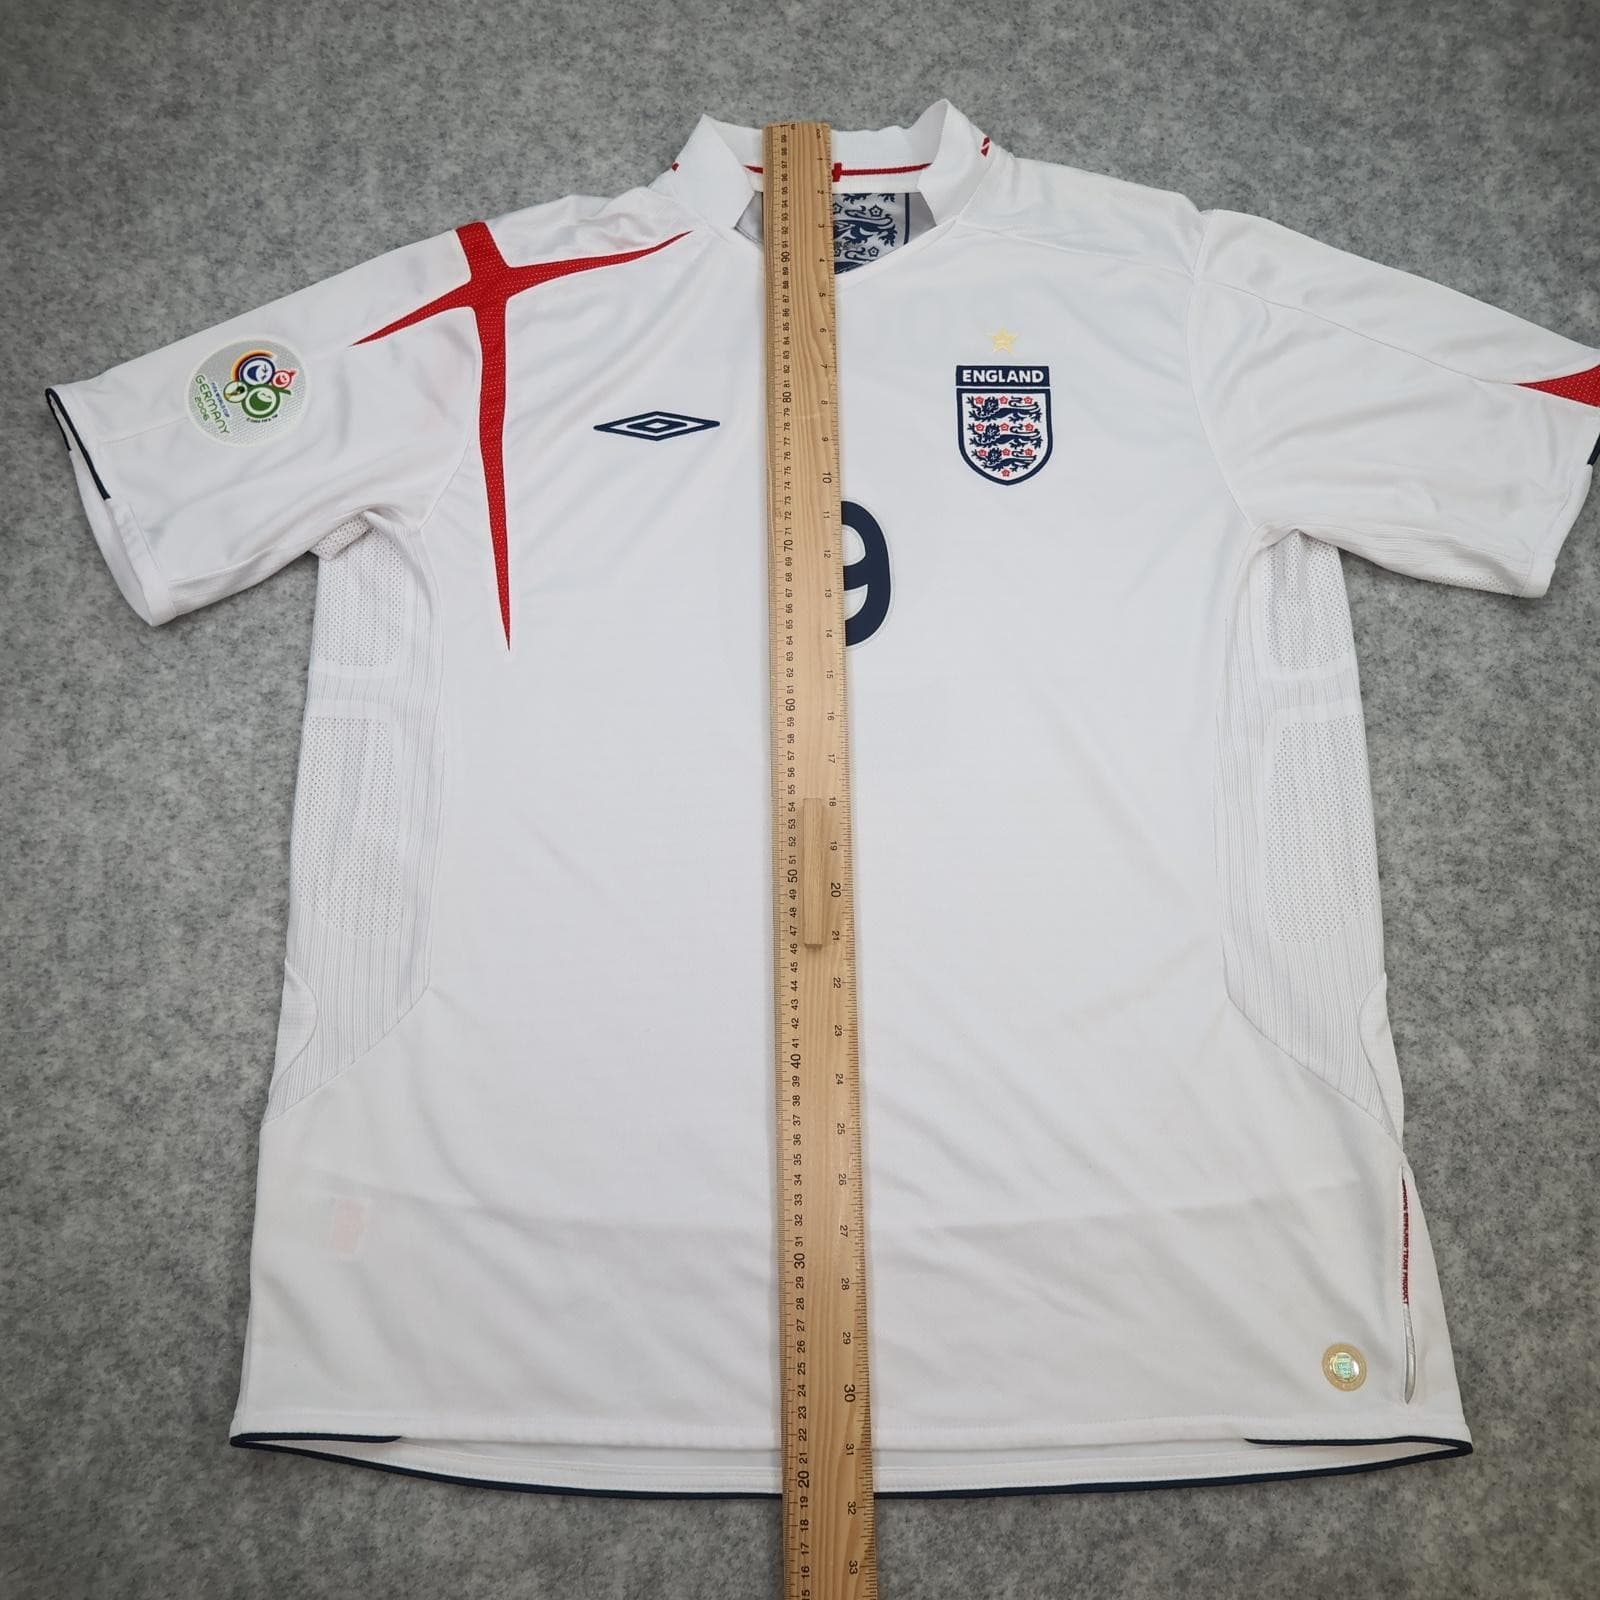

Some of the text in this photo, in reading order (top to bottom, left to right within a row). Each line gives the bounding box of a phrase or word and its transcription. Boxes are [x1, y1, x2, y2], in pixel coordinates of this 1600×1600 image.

[962, 369, 1044, 383] ENGLAND
[195, 374, 230, 434] GERMANY
[195, 396, 210, 421] 2006
[823, 472, 832, 483] 10
[824, 550, 831, 559] 12
[825, 589, 832, 598] 13
[826, 670, 833, 679] 15
[827, 712, 835, 720] 16
[787, 717, 794, 727] 59
[787, 734, 794, 743] 58
[787, 751, 794, 760] 57
[828, 754, 835, 763] 17
[788, 767, 795, 777] 56
[788, 784, 795, 794] 55
[788, 802, 795, 812] 54
[829, 797, 836, 806] 18
[788, 819, 795, 829] 53
[789, 836, 796, 847] 52
[830, 841, 837, 850] 19
[789, 856, 796, 864] 51
[788, 869, 797, 883] 50
[789, 889, 796, 900] 49
[831, 882, 841, 897] 20
[789, 907, 797, 918] 48
[790, 926, 797, 936] 47
[832, 931, 840, 940] 21
[790, 944, 797, 954] 46
[791, 962, 798, 973] 45
[791, 980, 798, 992] 44
[833, 977, 841, 988] 22
[791, 999, 798, 1010] 43
[791, 1018, 799, 1029] 42
[835, 1025, 842, 1037] 23
[792, 1039, 799, 1048] 41
[791, 1054, 801, 1069] 40
[792, 1076, 800, 1087] 39
[836, 1074, 843, 1085] 24
[792, 1095, 800, 1106] 38
[793, 1114, 800, 1126] 37
[837, 1123, 845, 1135] 25
[793, 1134, 801, 1145] 36
[793, 1154, 801, 1165] 35
[794, 1174, 802, 1185] 34
[839, 1173, 846, 1185] 26
[794, 1194, 802, 1206] 33
[795, 1214, 802, 1226] 32
[840, 1225, 848, 1237] 27
[795, 1237, 803, 1247] 31
[794, 1253, 805, 1269] 30
[796, 1277, 804, 1288] 29
[841, 1278, 849, 1290] 28
[796, 1298, 804, 1310] 28
[797, 1319, 804, 1331] 27
[843, 1332, 851, 1344] 29
[797, 1340, 805, 1353] 26
[797, 1362, 805, 1375] 25
[798, 1384, 806, 1397] 24
[844, 1384, 855, 1402] 30
[798, 1406, 806, 1419] 23
[799, 1428, 807, 1441] 22
[846, 1444, 854, 1455] 31
[799, 1453, 807, 1464] 21
[798, 1471, 809, 1488] 20
[800, 1496, 808, 1509] 19
[848, 1501, 856, 1515] 32
[800, 1519, 809, 1532] 18
[801, 1542, 809, 1555] 17
[801, 1566, 809, 1579] 16
[849, 1561, 858, 1574] 33
